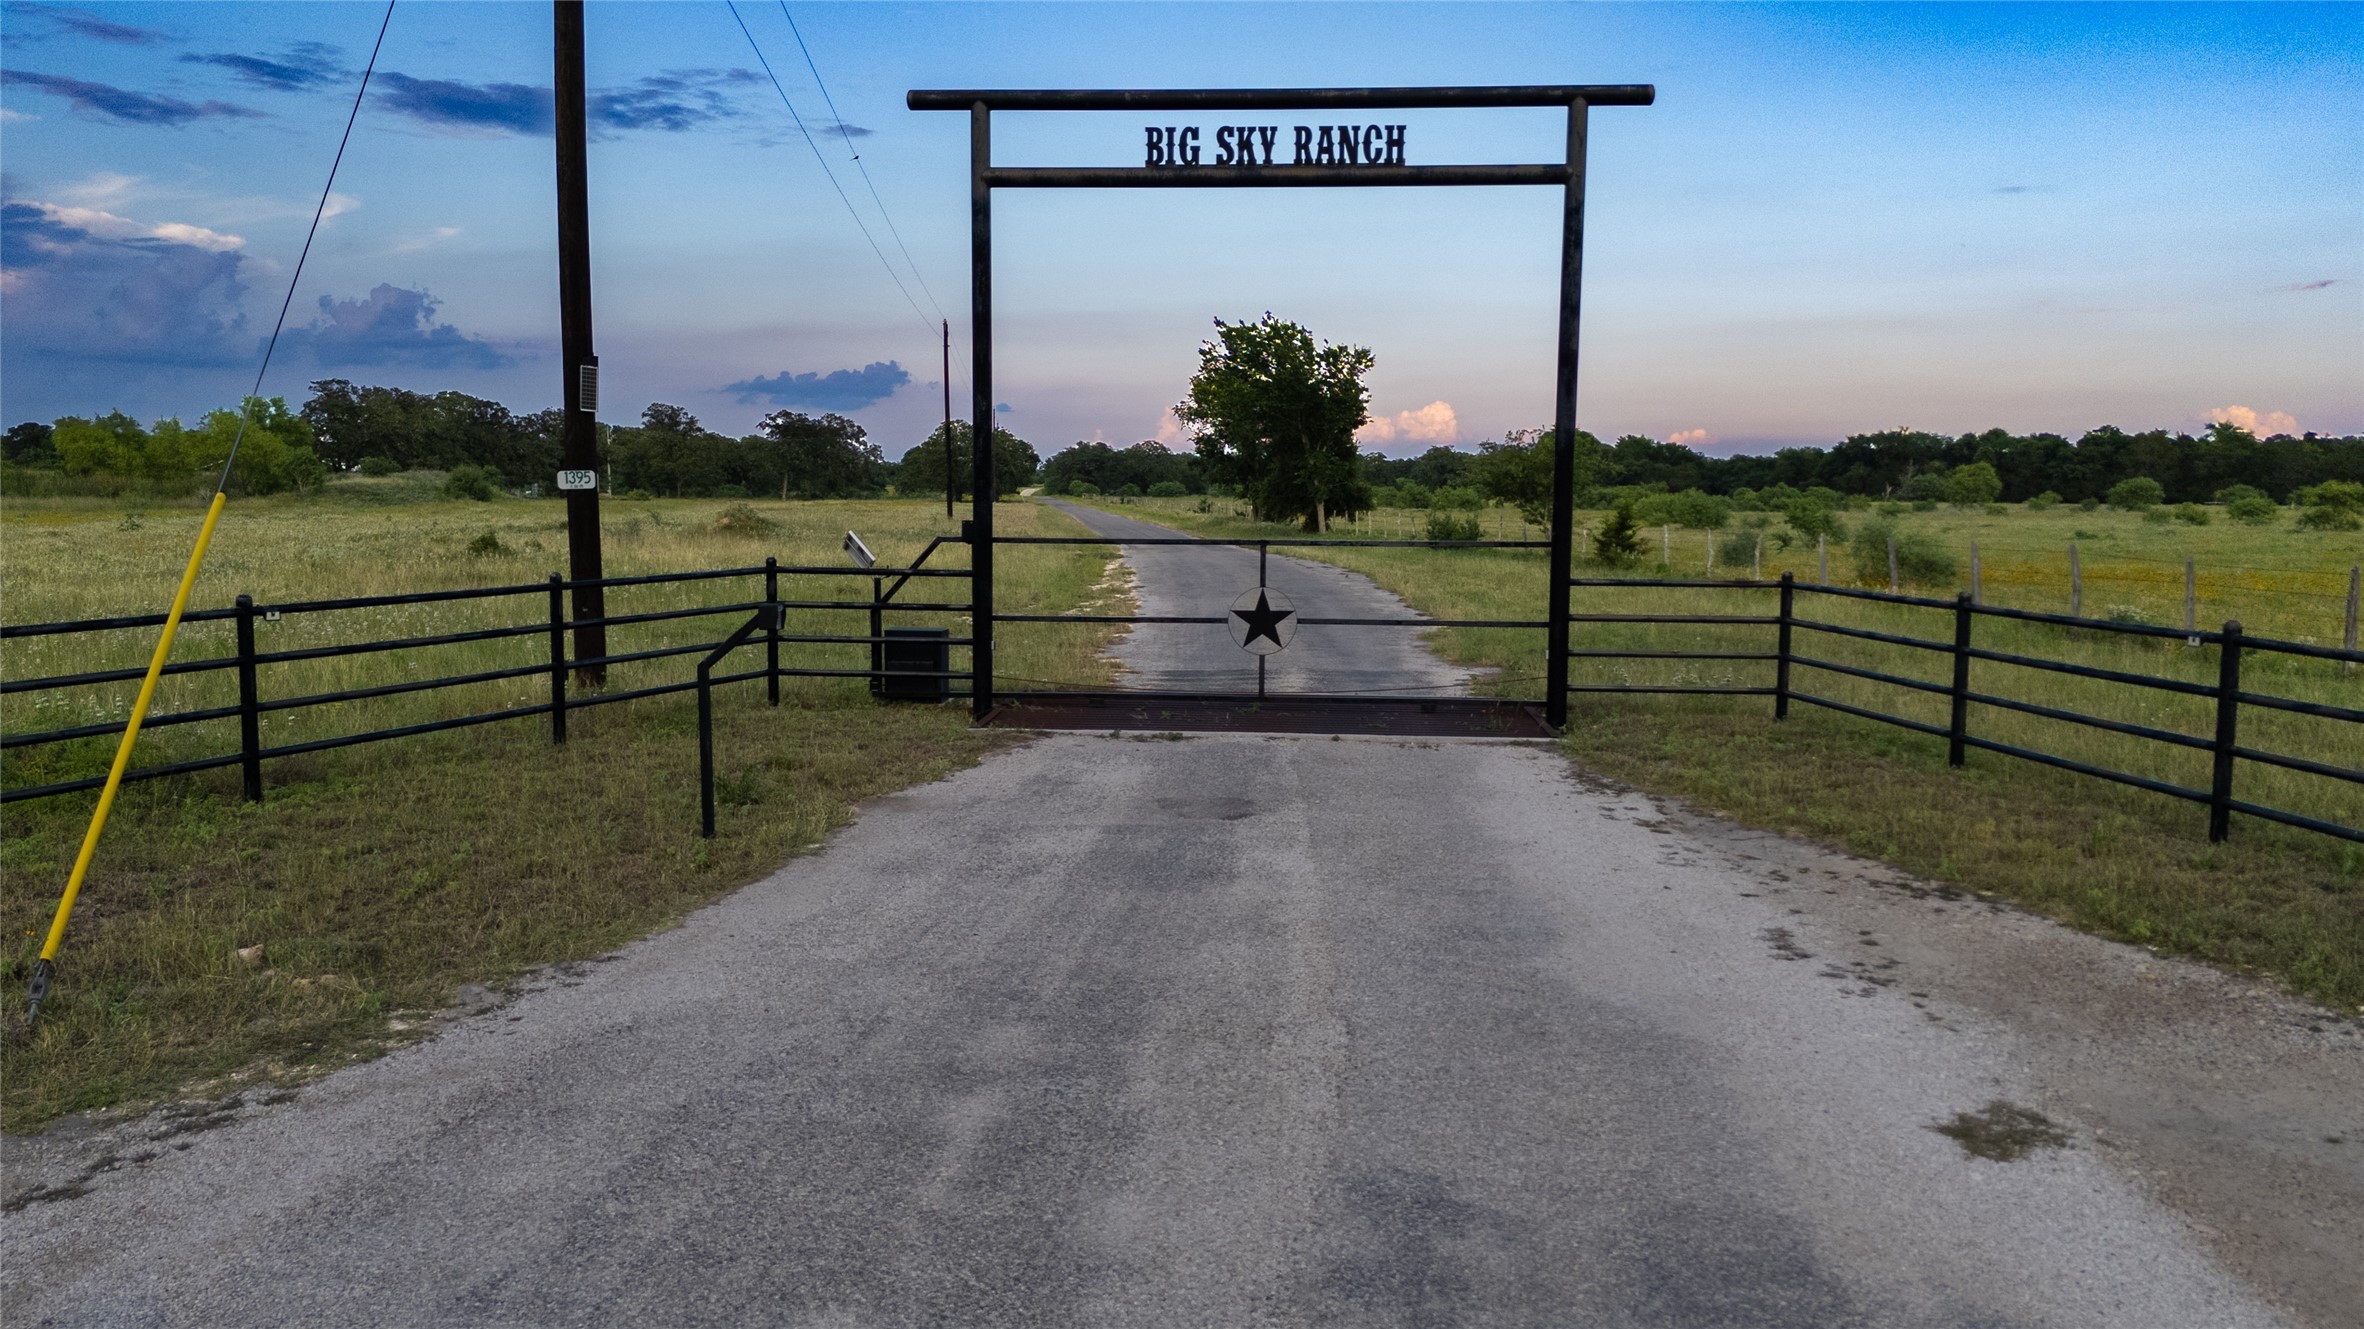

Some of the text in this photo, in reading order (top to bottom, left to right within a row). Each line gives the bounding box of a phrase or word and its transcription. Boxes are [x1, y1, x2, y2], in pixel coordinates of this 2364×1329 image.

[1145, 124, 1407, 166] BIG SKY RANCH
[564, 471, 592, 484] 1395
